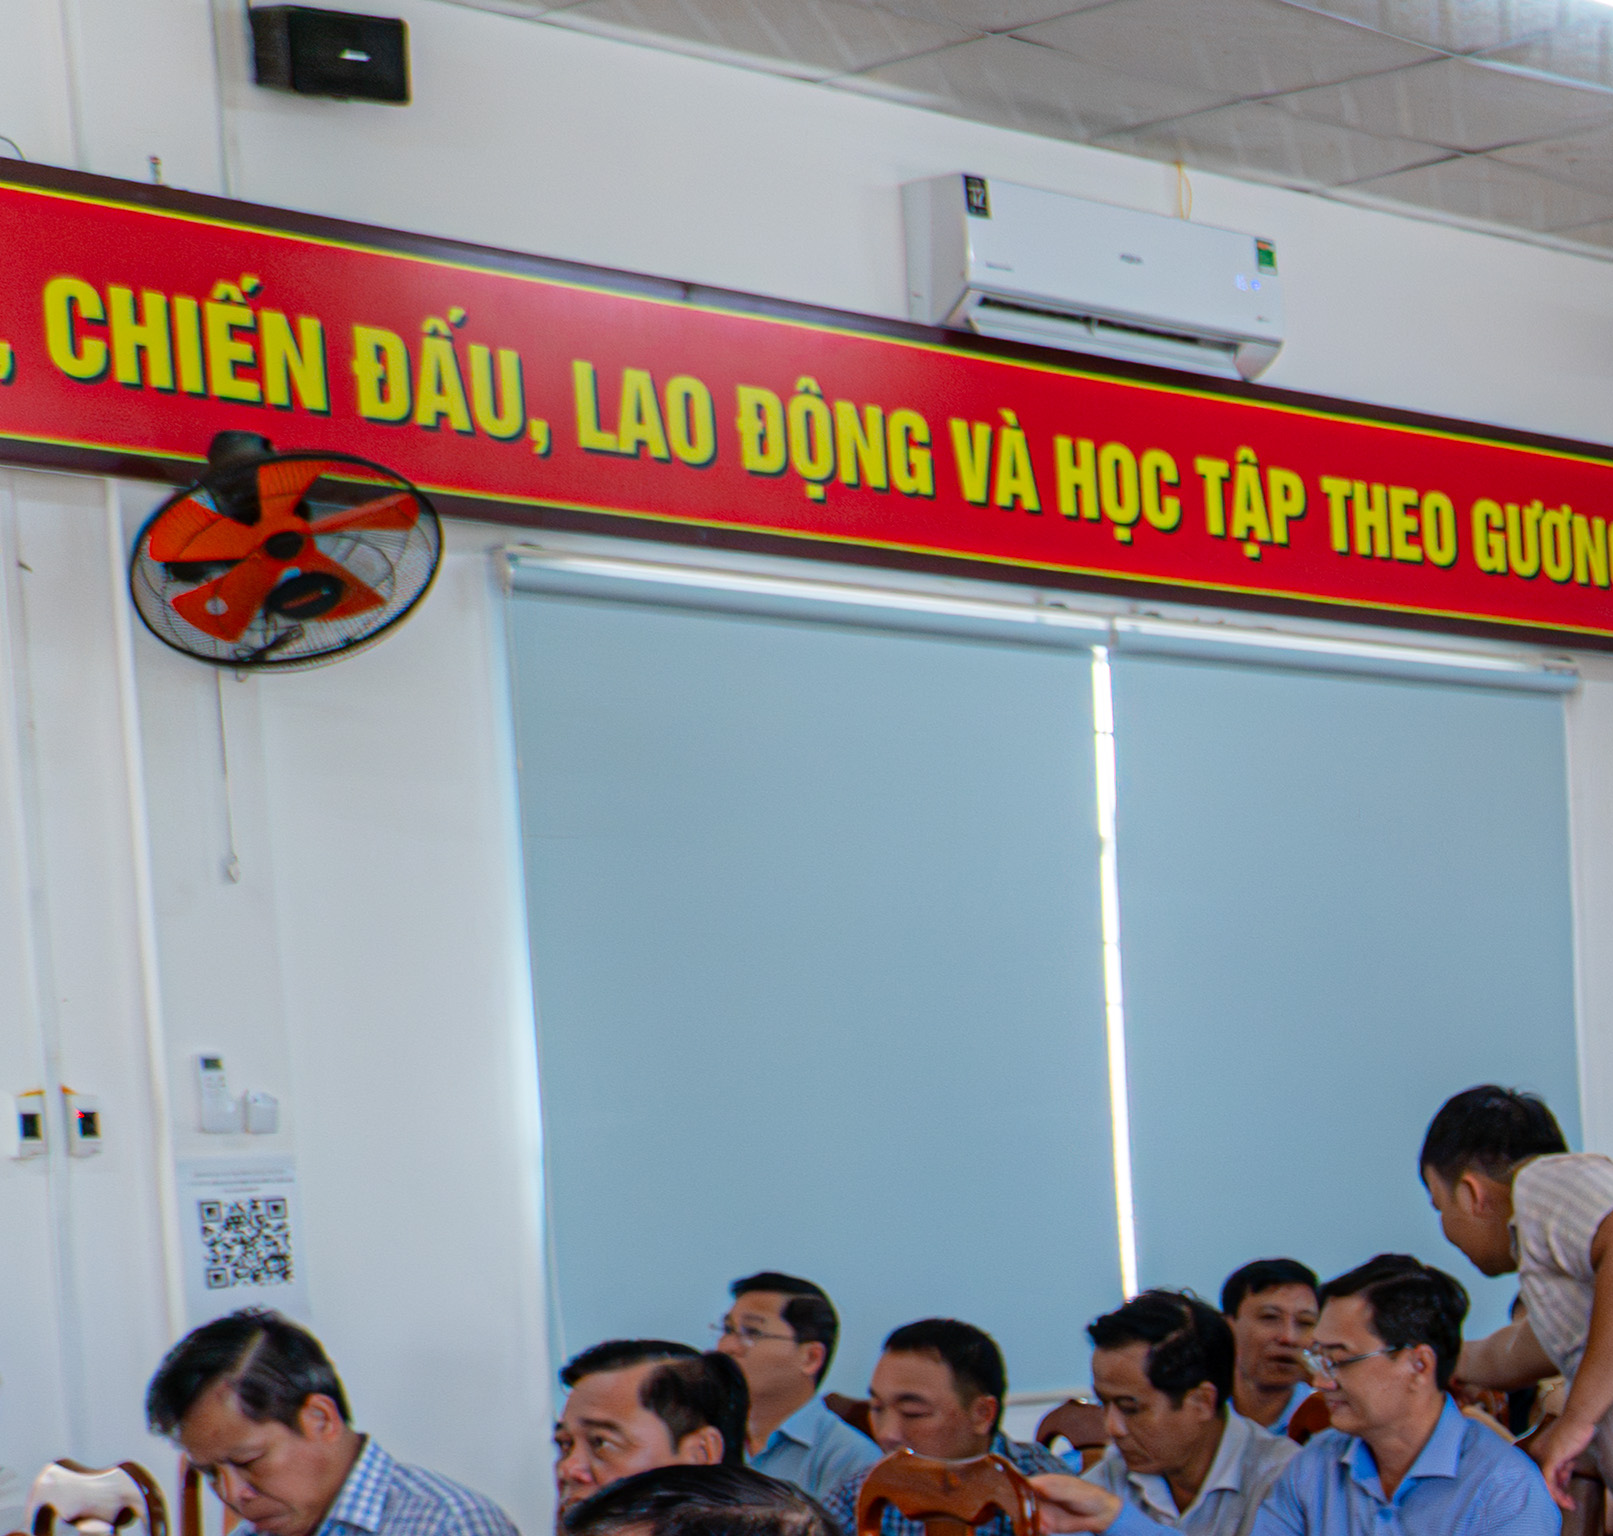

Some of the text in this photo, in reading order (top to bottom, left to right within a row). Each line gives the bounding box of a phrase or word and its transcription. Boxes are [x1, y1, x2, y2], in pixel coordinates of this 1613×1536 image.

[43, 275, 327, 411] CHIẾN
[351, 305, 551, 455] ĐẤU,
[571, 358, 714, 465] LAO
[735, 375, 934, 500] ĐỘNG
[950, 409, 1039, 512] VÀ
[1055, 436, 1181, 542] HỌC
[1195, 447, 1306, 559] TẬP
[1320, 476, 1457, 567] THEO
